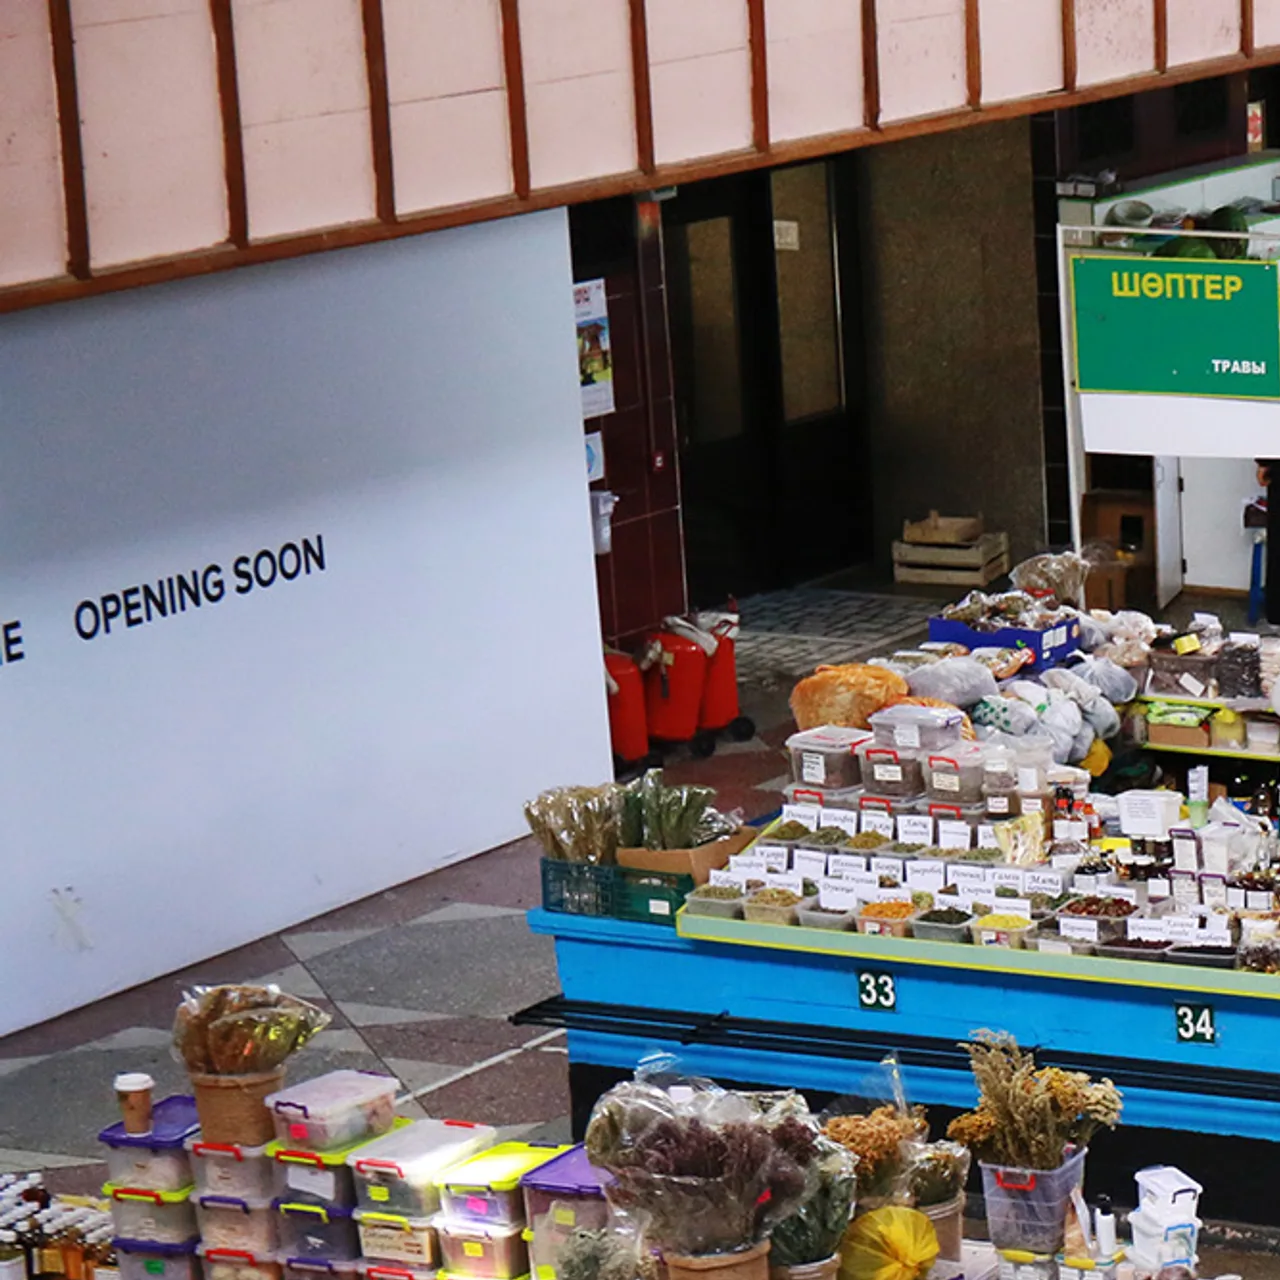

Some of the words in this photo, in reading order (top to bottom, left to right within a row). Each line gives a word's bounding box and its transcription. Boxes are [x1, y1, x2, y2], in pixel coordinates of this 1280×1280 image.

[1111, 271, 1243, 300] ШӨПТЕР
[1211, 359, 1266, 375] ТРАВЫ
[74, 563, 226, 641] OPENING
[232, 534, 326, 595] SOON
[860, 973, 895, 1007] 33
[1177, 1006, 1214, 1040] 34
